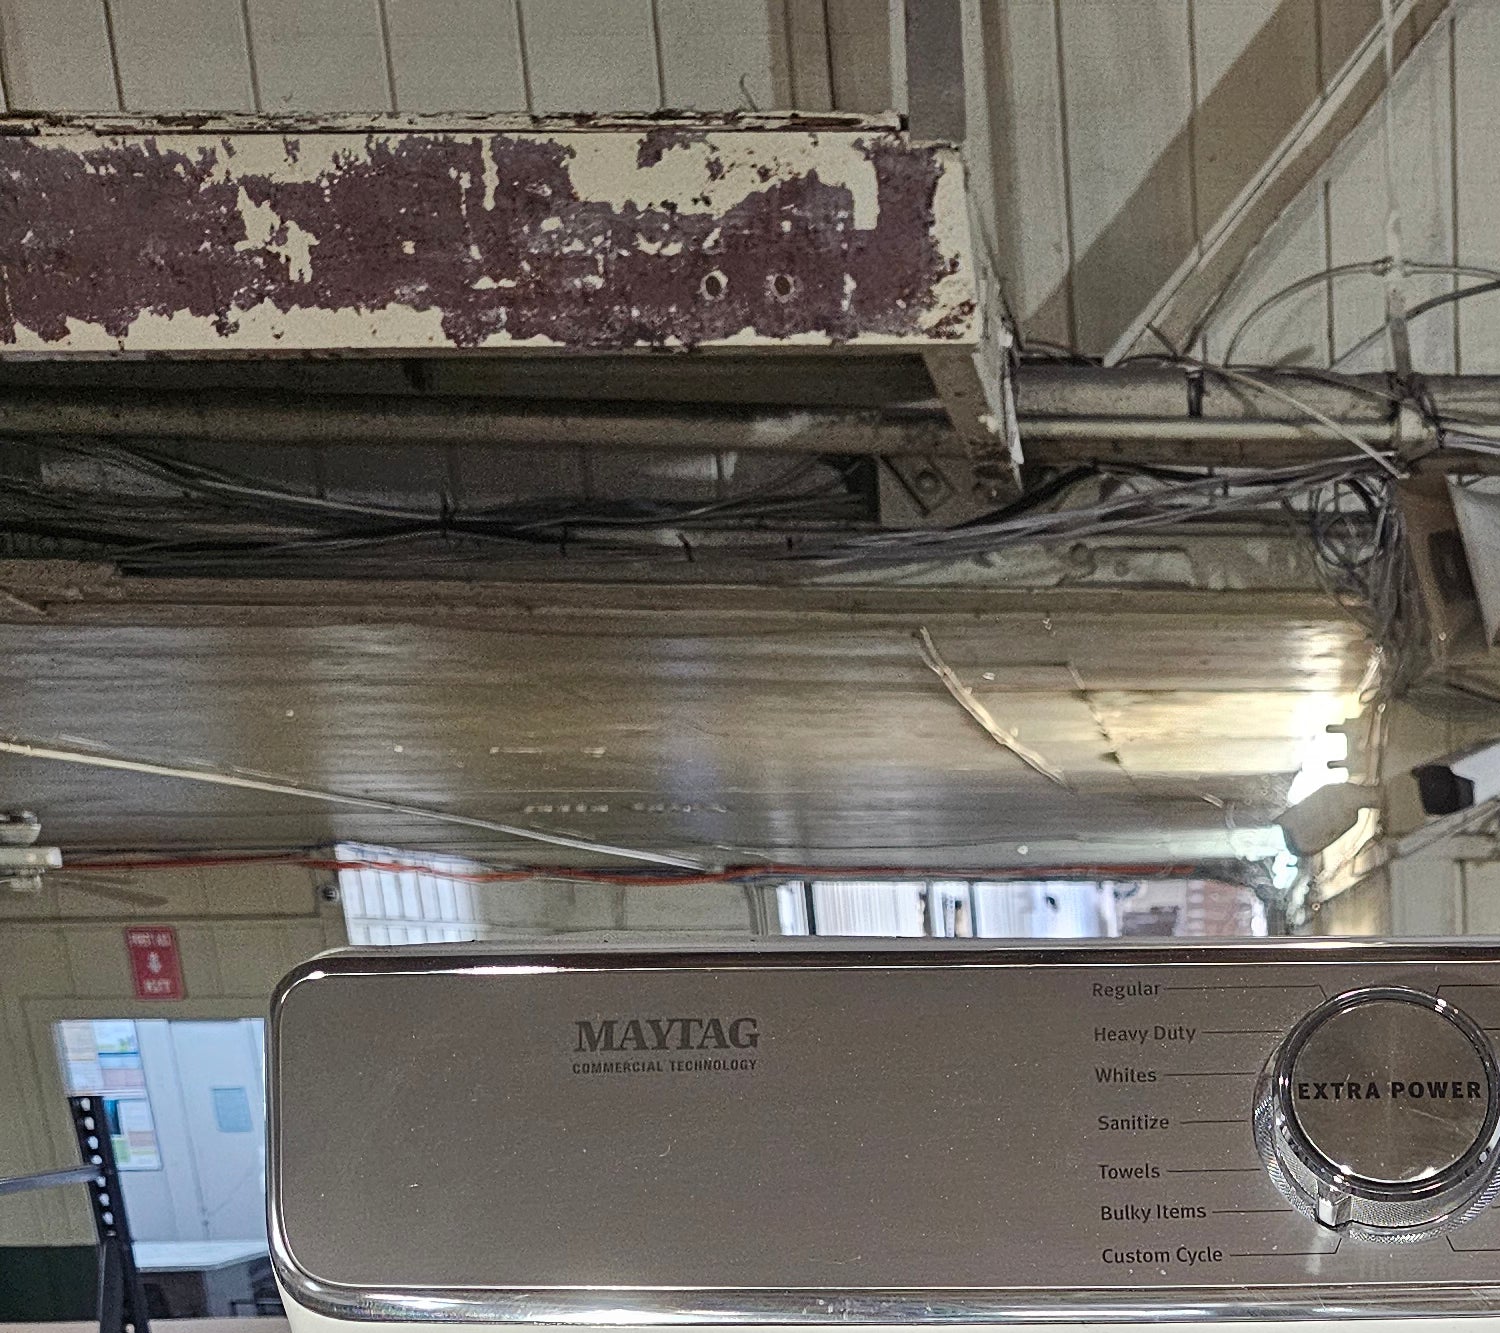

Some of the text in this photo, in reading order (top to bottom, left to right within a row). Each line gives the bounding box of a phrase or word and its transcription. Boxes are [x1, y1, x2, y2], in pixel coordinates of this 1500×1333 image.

[1092, 982, 1161, 1000] Regular
[573, 1017, 760, 1052] MAYTAG
[1094, 1025, 1197, 1044] Heavy Duty
[572, 1059, 758, 1074] COMMERCIAL TECHNOLOGY
[1095, 1067, 1157, 1083] Whites
[1298, 1080, 1482, 1100] EXTRA POWER
[1098, 1115, 1170, 1131] Sanitize
[1099, 1164, 1160, 1179] Towels
[1101, 1205, 1207, 1223] Bulky Items
[1102, 1247, 1223, 1266] Custom Cycle
